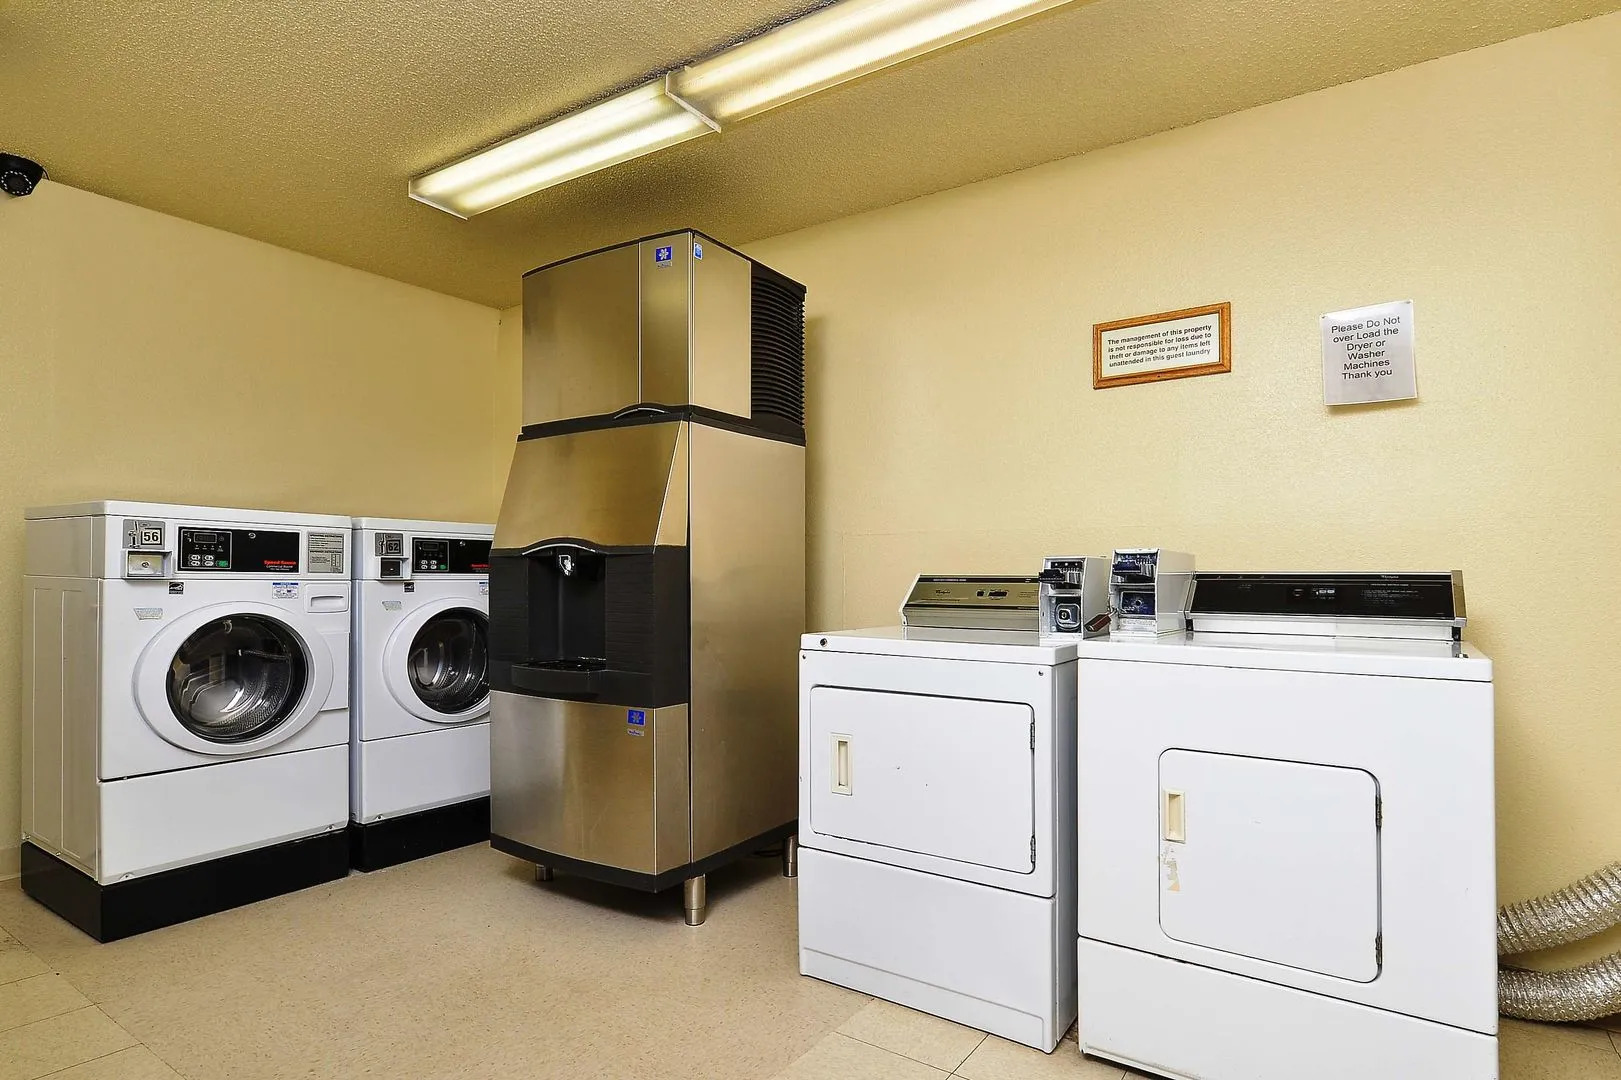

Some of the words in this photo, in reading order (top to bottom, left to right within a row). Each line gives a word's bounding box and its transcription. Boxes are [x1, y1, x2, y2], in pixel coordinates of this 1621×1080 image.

[1331, 323, 1364, 333] Please
[1366, 320, 1380, 329] Do
[1383, 316, 1400, 326] Not
[1120, 333, 1161, 342] management
[1184, 325, 1212, 335] property
[1333, 334, 1354, 343] over
[1356, 330, 1381, 340] Load
[1383, 327, 1399, 336] the
[1127, 340, 1164, 350] responsible
[1132, 348, 1158, 356] damage
[1180, 342, 1199, 350] items
[1346, 341, 1373, 351] Dryer
[1375, 340, 1386, 348] or
[1109, 357, 1144, 367] unattended
[1166, 352, 1185, 361] guest
[1185, 349, 1211, 357] laundry
[1347, 350, 1385, 360] Washer
[1343, 359, 1390, 370] Machines
[1342, 371, 1372, 380] Thank
[1374, 369, 1393, 378] you
[143, 531, 159, 542] 56
[388, 542, 399, 551] 62
